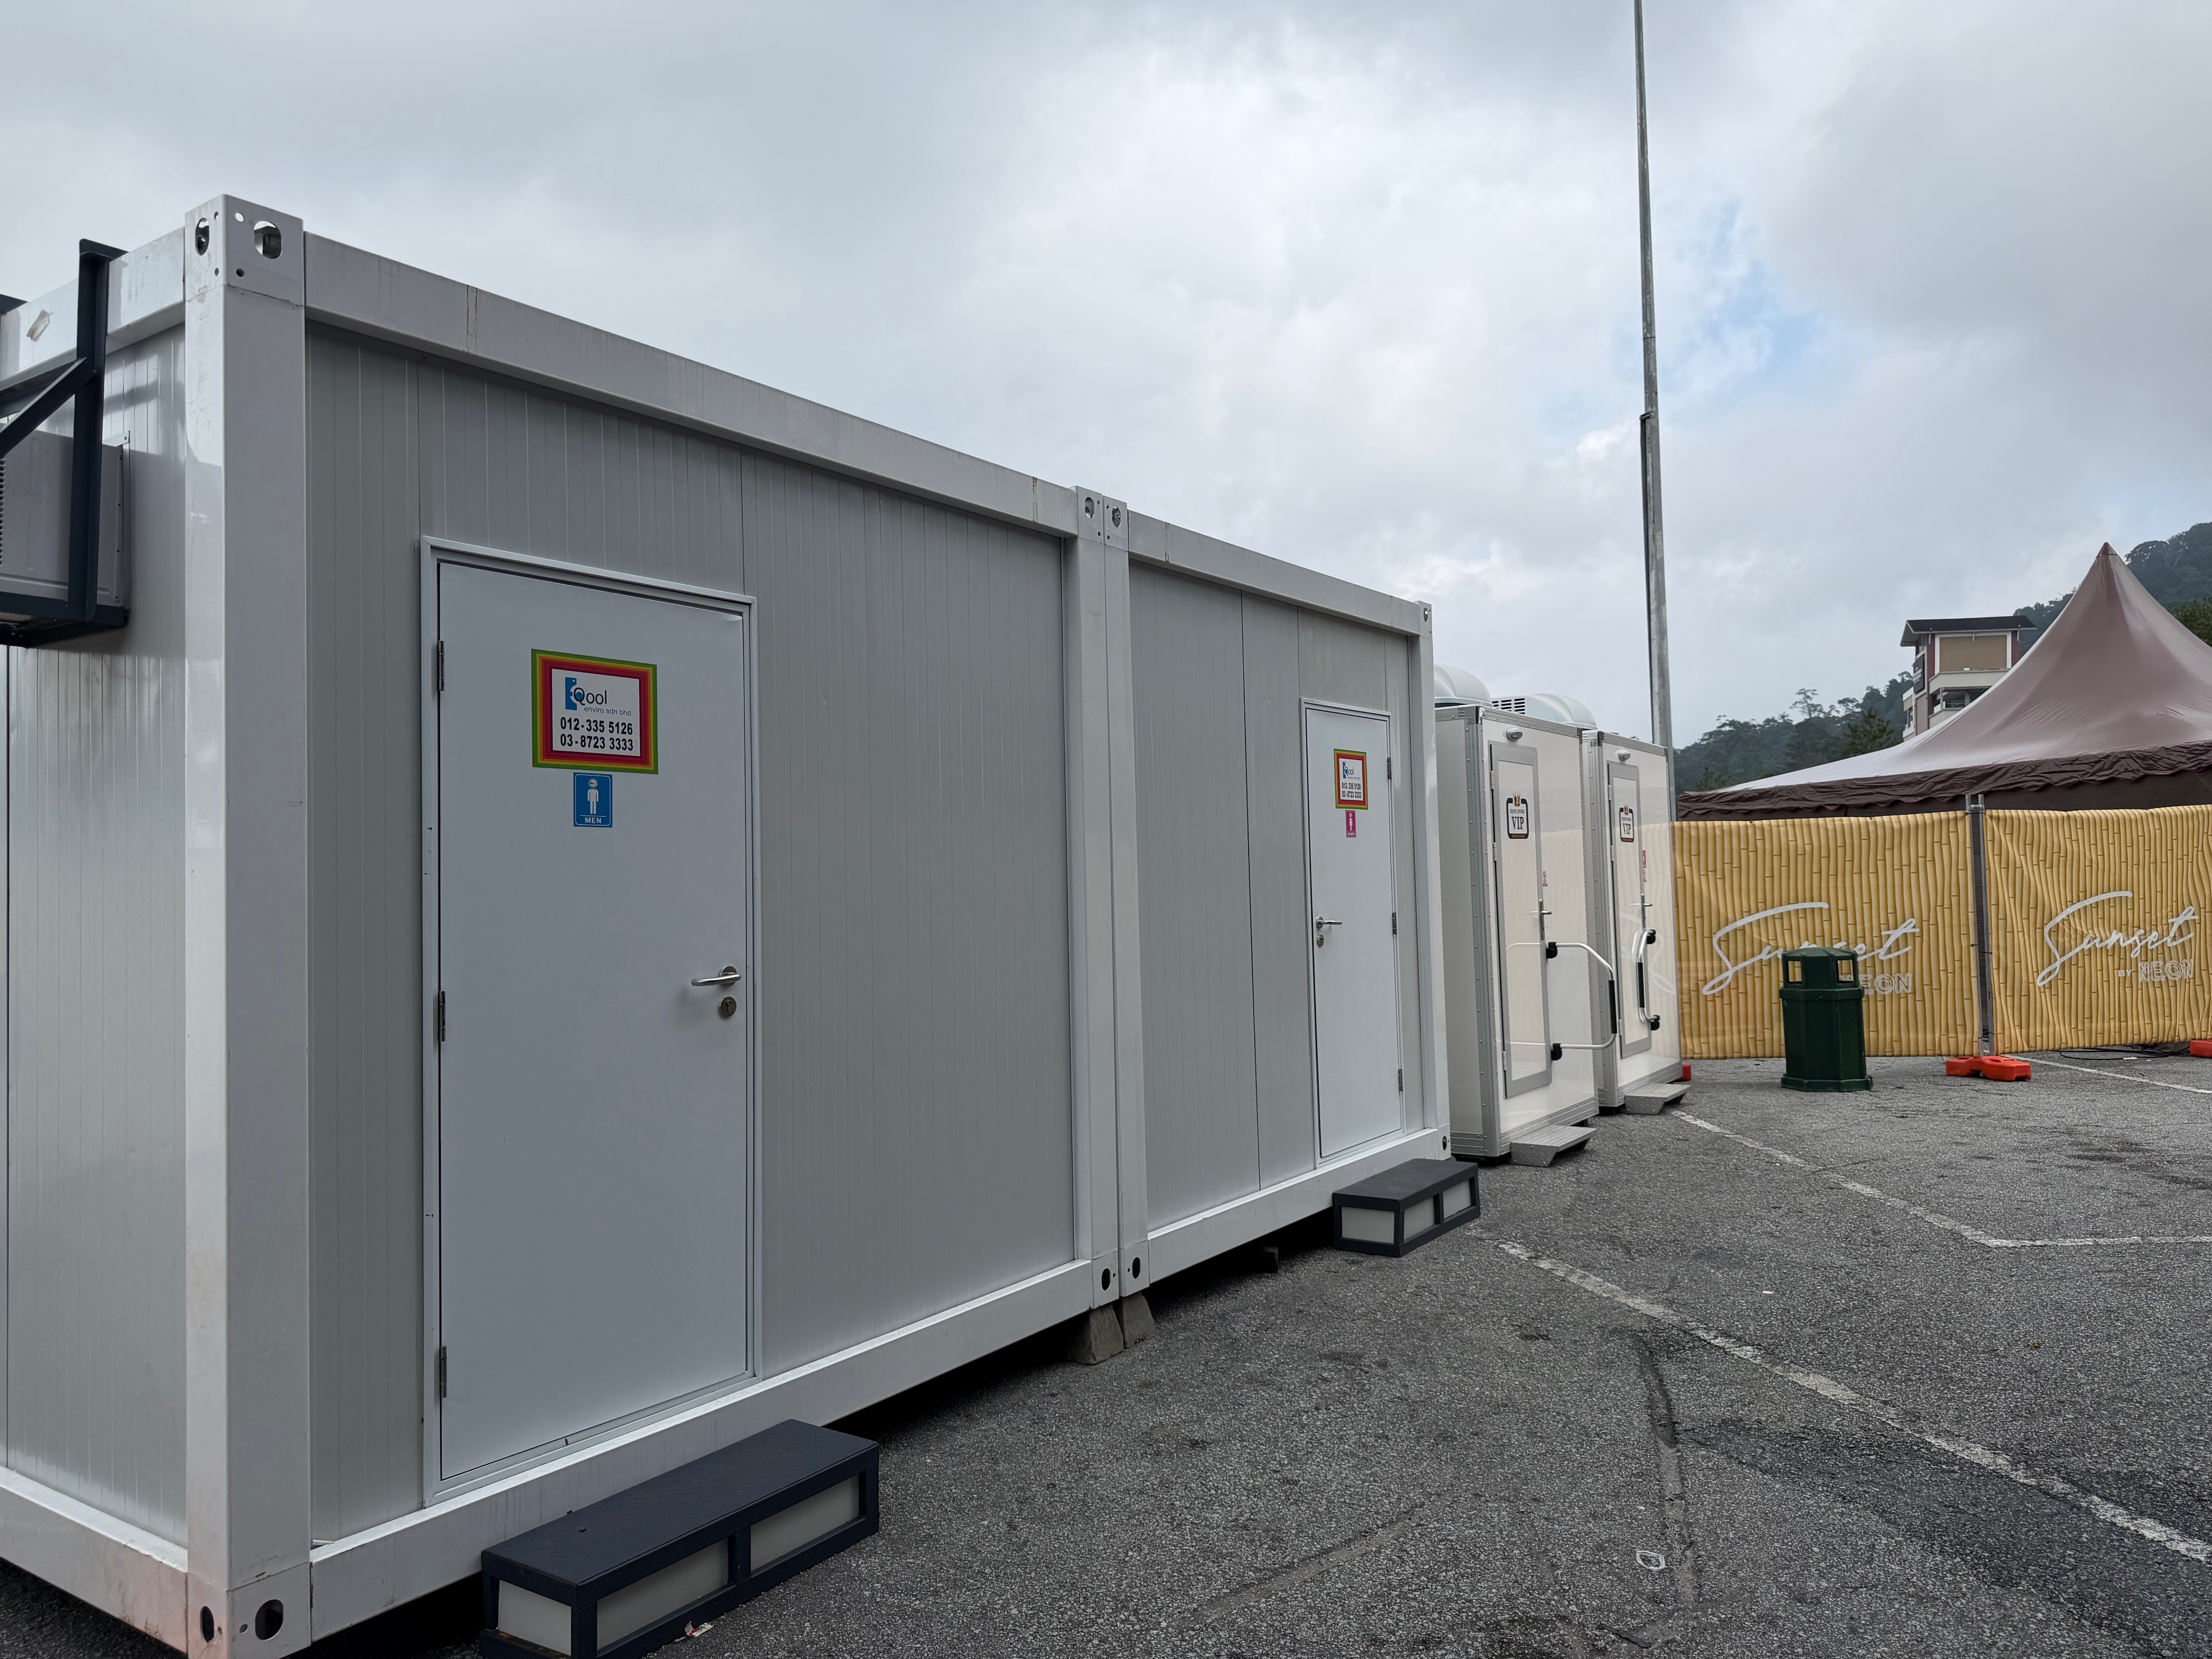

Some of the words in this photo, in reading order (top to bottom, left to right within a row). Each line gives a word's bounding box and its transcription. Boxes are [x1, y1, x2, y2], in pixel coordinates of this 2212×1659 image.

[609, 721, 633, 735] 5126
[609, 737, 633, 751] 3333
[1512, 816, 1524, 830] VIP
[1623, 823, 1631, 835] VIP
[2037, 891, 2199, 987] Sunset
[1702, 902, 1920, 995] Suet
[2138, 958, 2193, 982] NEON
[1839, 973, 1912, 995] EON
